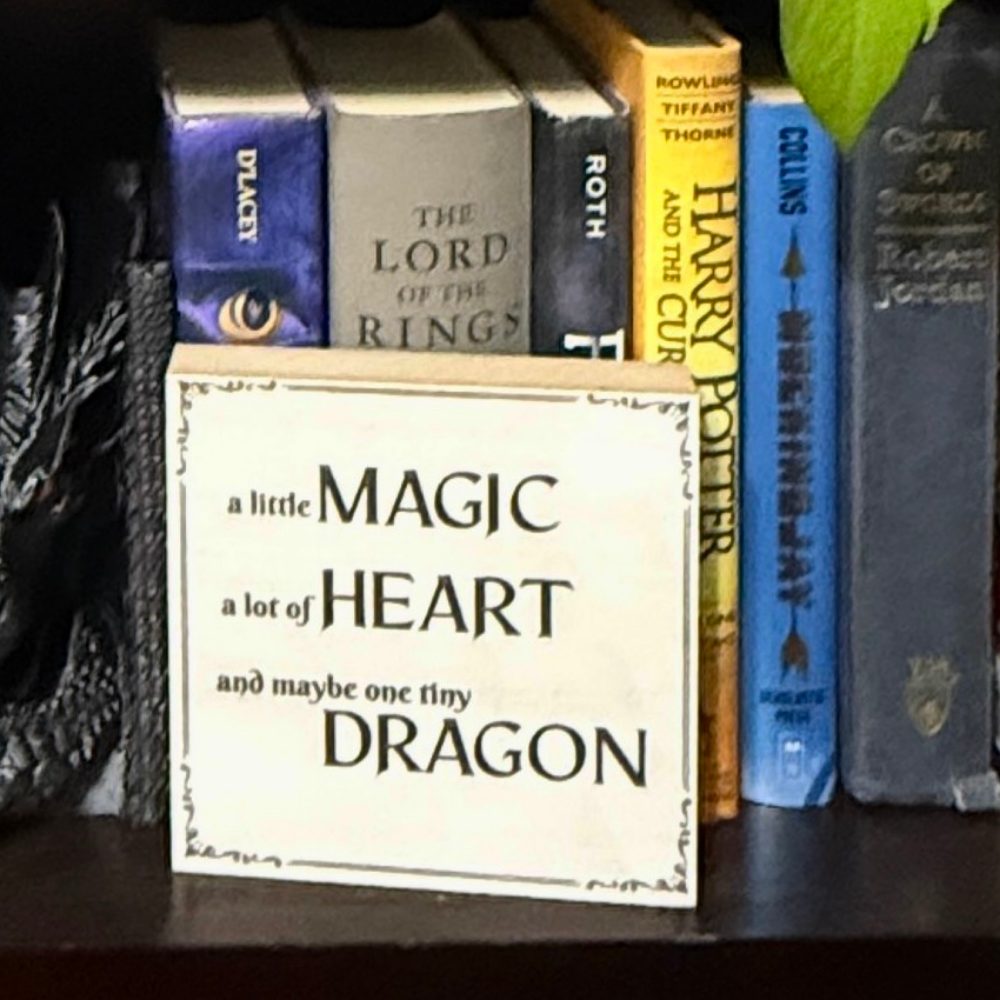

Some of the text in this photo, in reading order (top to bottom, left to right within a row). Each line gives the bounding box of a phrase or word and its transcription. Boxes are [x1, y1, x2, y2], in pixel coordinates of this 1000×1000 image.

[661, 100, 736, 116] TIFFANY
[660, 126, 736, 142] THORNE
[778, 127, 808, 215] COLLINS
[413, 203, 477, 229] THE
[585, 154, 607, 239] ROTH
[663, 189, 681, 238] AND
[373, 232, 508, 274] LORD
[663, 243, 681, 283] THE
[396, 279, 487, 304] OF THE
[358, 303, 522, 348] RINGS
[690, 182, 739, 562] HARRY POTTER
[227, 465, 561, 538] a little MAGIC
[221, 568, 575, 641] a lot of HEART
[217, 670, 472, 709] and maybe one tiny
[323, 708, 648, 789] DRAGON
